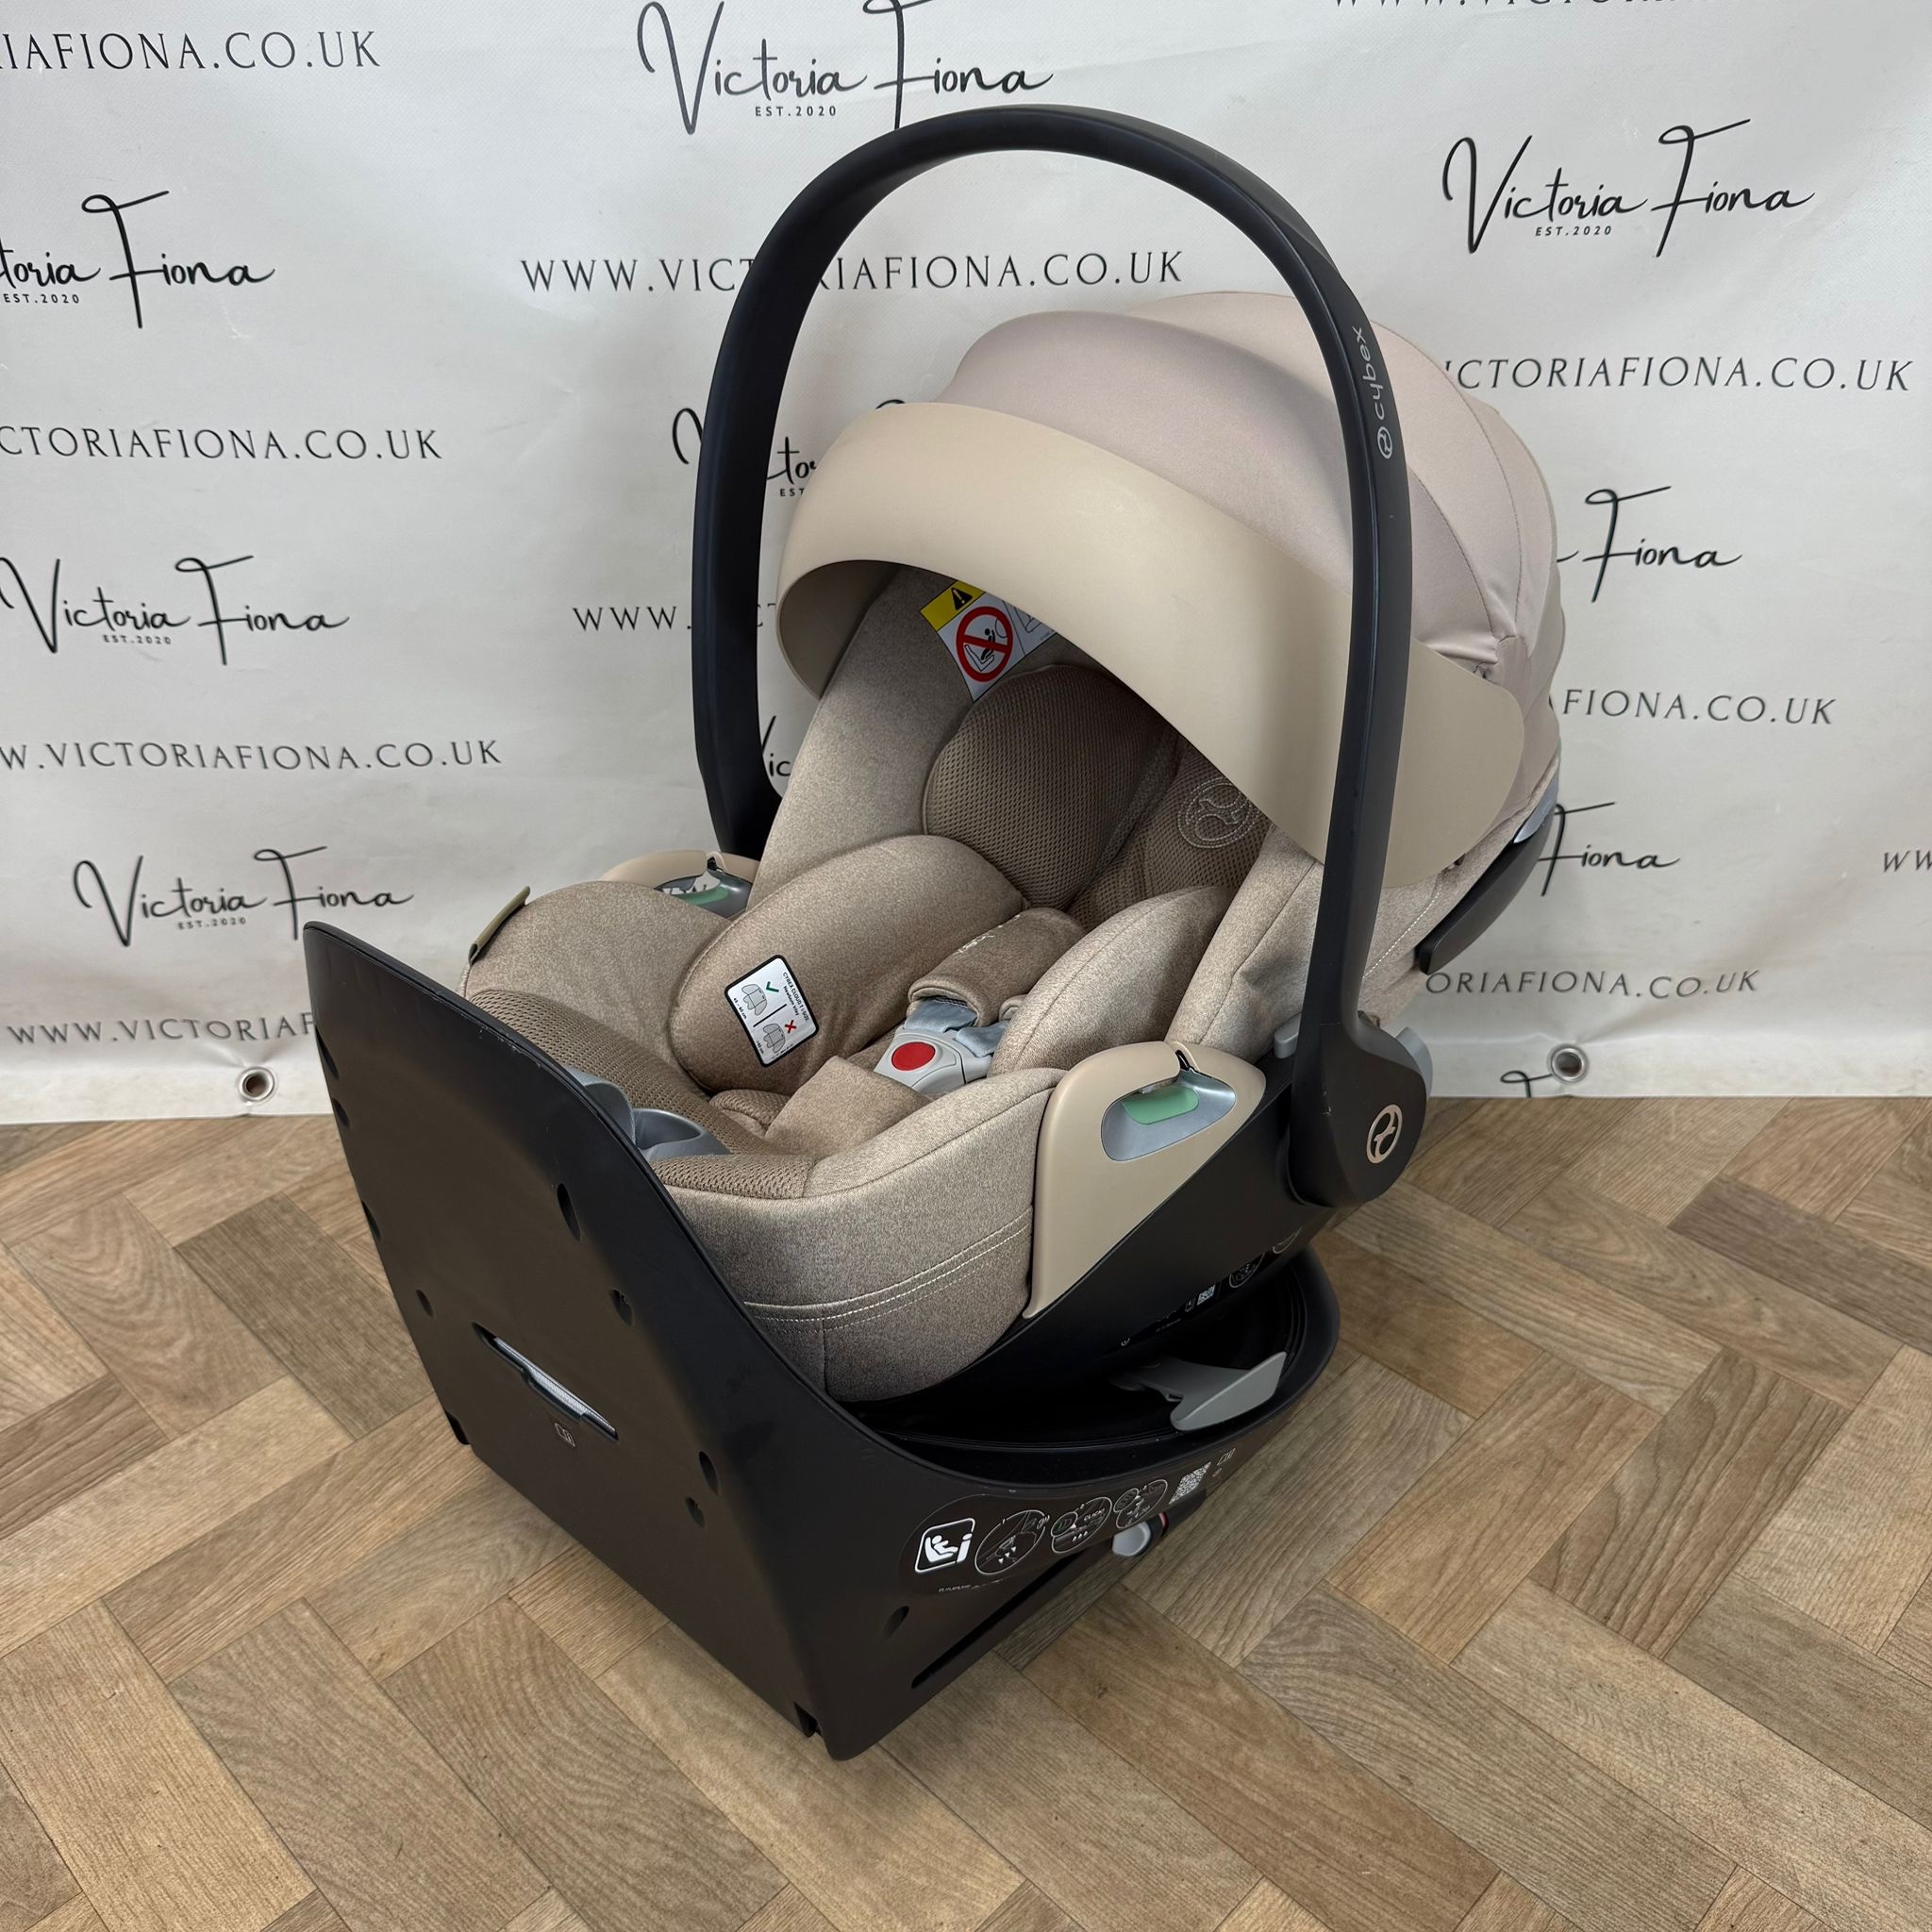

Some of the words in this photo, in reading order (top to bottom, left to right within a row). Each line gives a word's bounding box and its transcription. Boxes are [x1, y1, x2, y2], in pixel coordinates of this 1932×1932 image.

[0, 31, 381, 70] IAFIONA.CO.UK
[637, 1, 868, 135] Victoria
[862, 0, 1055, 130] Fiona
[756, 106, 837, 117] EST.2020
[1442, 135, 1648, 254] Victoria
[1651, 119, 1816, 258] Fiona
[81, 191, 275, 329] Fiona
[1536, 225, 1612, 236] EST.2020
[3, 293, 79, 304] EST.2020
[1352, 325, 1385, 420] cybex
[0, 425, 442, 459] CTORIAFIONA.CO.UK
[1582, 486, 1742, 603] Fiona
[0, 557, 191, 654] Victoria
[175, 556, 350, 666] Fiona
[103, 635, 172, 645] EST.2020
[0, 740, 502, 770] W.VICTORIAFIONA.CO.UK
[1538, 802, 1680, 896] Fiona
[73, 856, 268, 947] Victoria
[253, 846, 414, 941] Fiona
[178, 916, 246, 929] EST.2020
